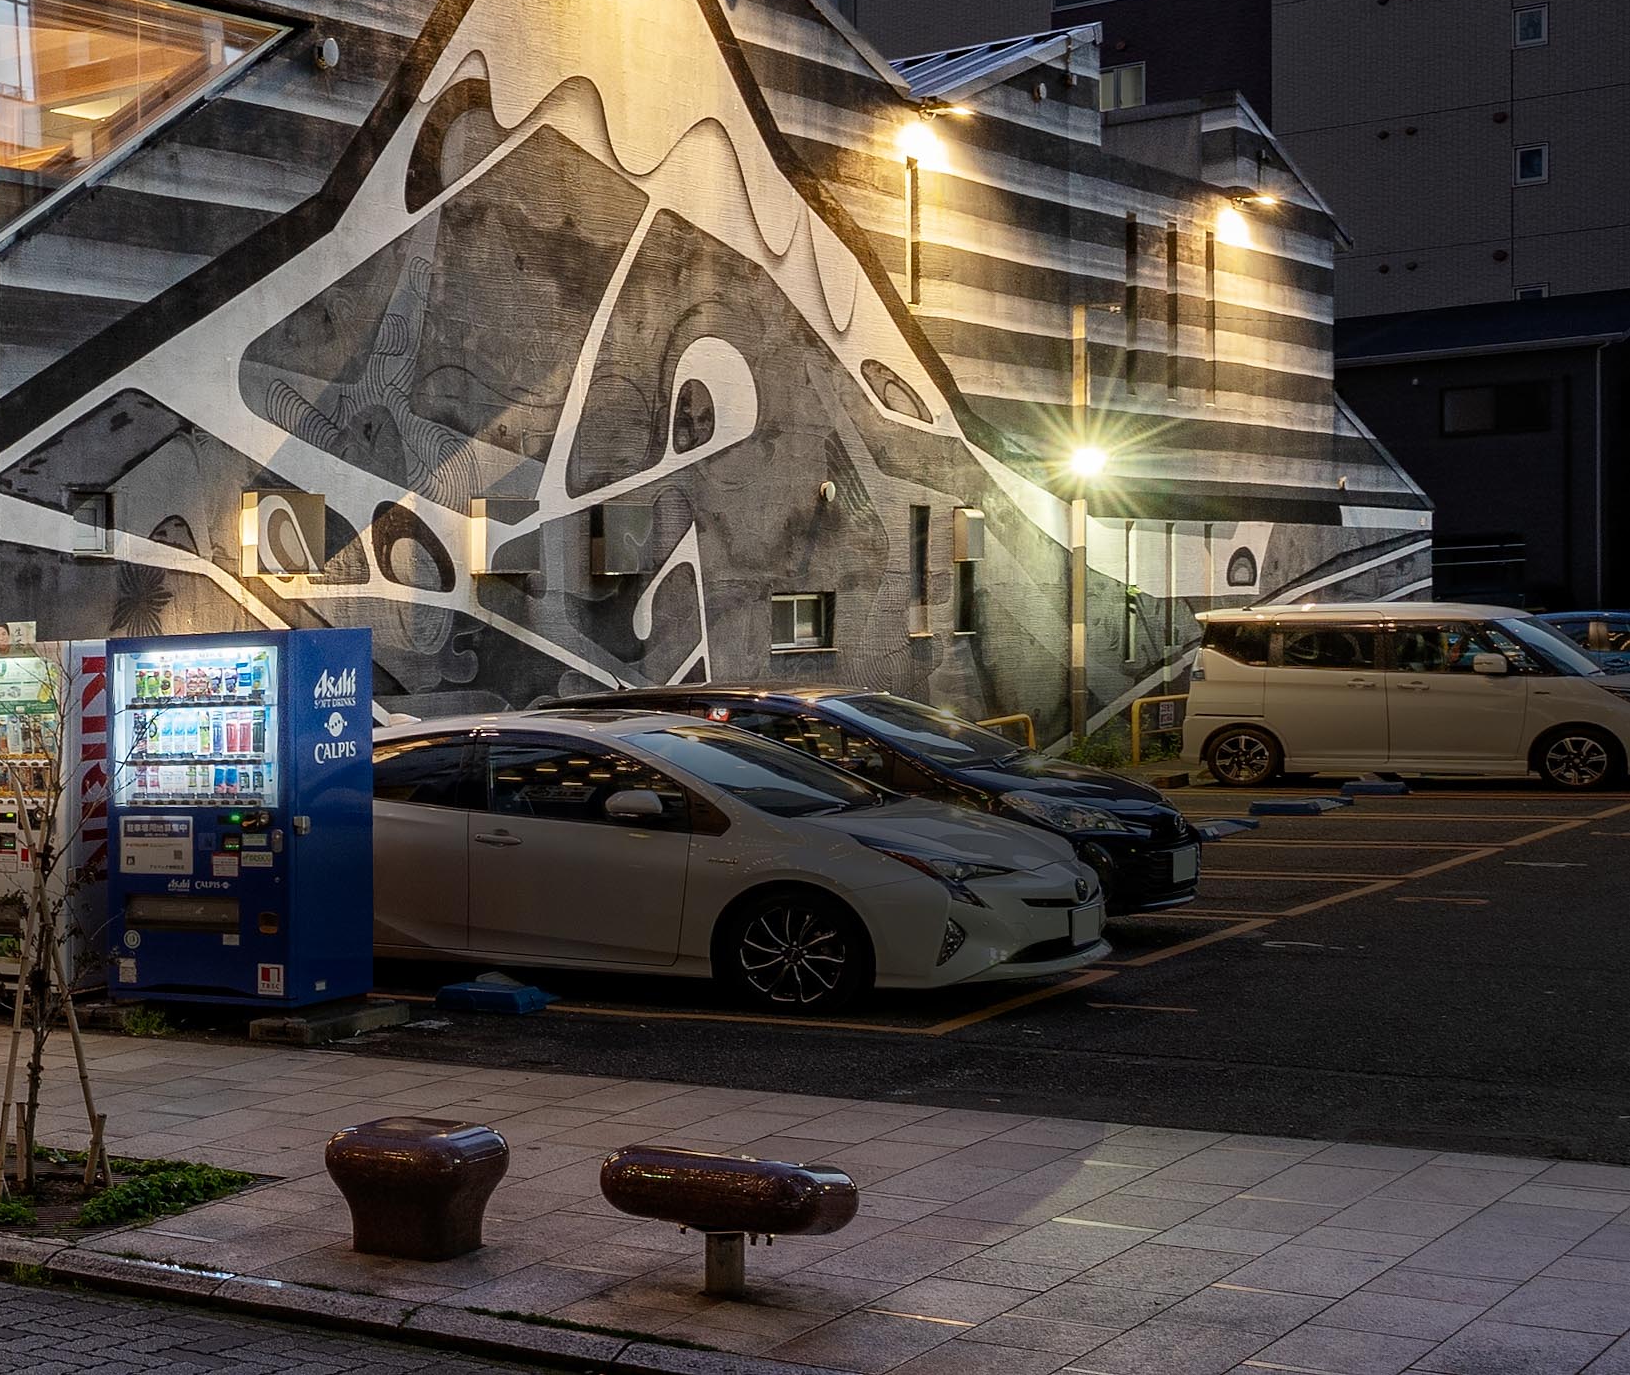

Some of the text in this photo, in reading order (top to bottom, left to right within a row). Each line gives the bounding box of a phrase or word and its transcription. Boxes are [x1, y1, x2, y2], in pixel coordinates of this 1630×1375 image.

[313, 668, 356, 698] Asahi
[332, 696, 356, 707] DRINKS
[314, 741, 356, 764] CALPIS
[167, 878, 221, 890] Asahi CALPIS
